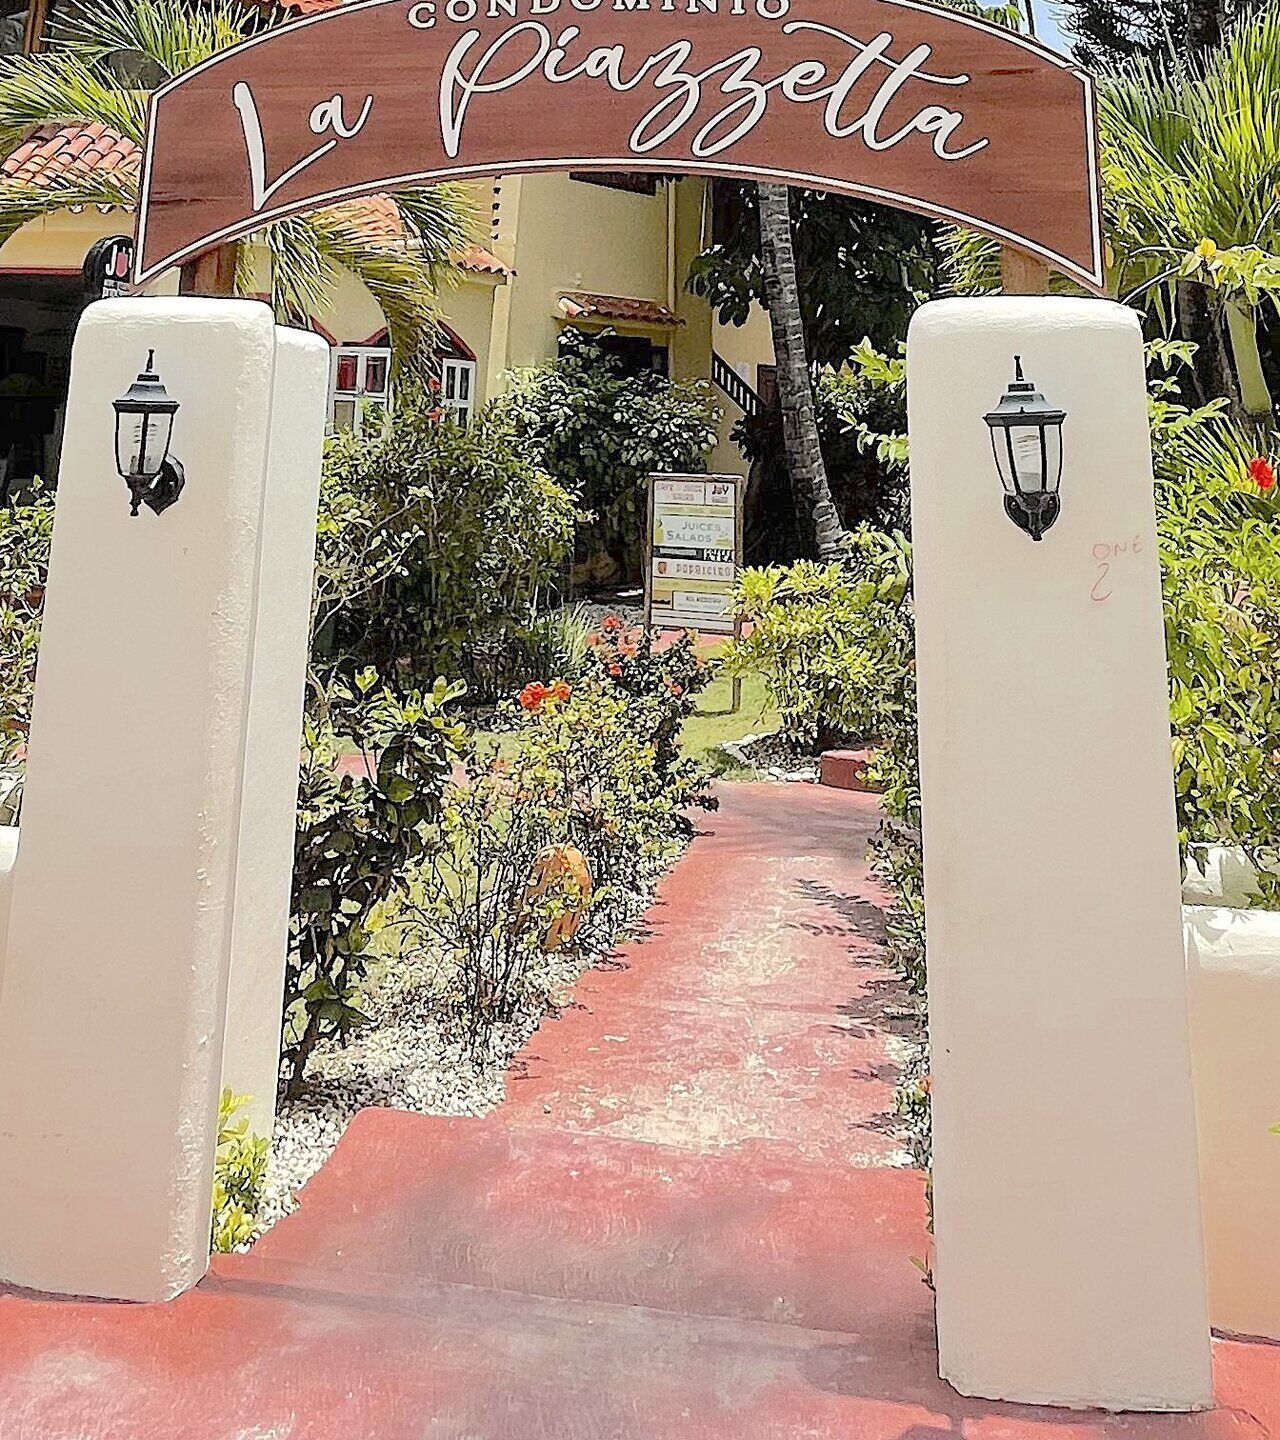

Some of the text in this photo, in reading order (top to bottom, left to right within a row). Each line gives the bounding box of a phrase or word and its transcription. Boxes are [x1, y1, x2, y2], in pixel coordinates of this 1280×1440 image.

[232, 19, 990, 211] La Piazzetta
[666, 530, 712, 543] SALADS
